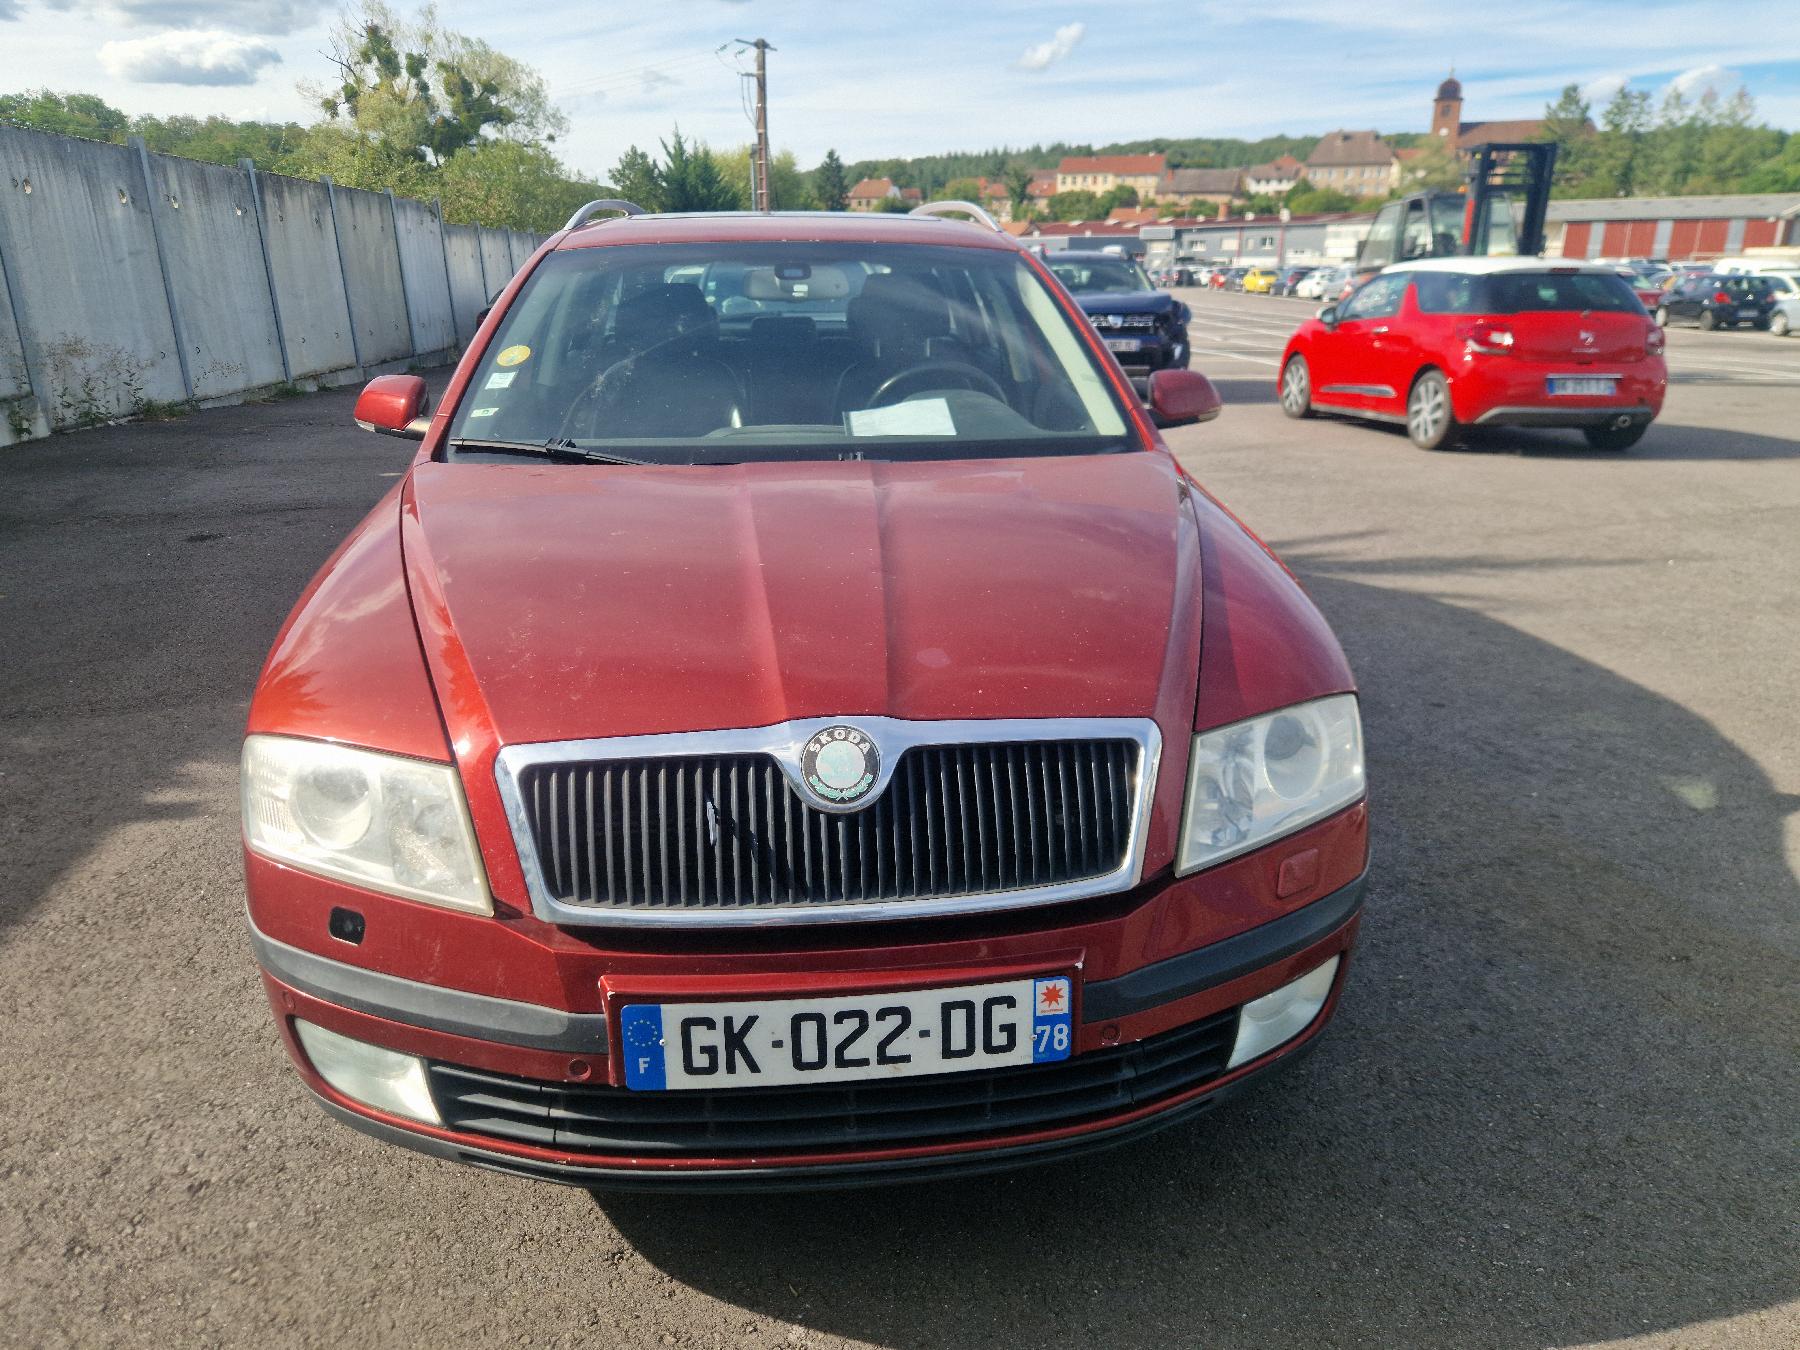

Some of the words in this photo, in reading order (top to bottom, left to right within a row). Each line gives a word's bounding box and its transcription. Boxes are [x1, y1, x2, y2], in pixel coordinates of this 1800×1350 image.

[681, 996, 1016, 1075] GK-022-DG
[1036, 1023, 1068, 1053] 78
[639, 1057, 650, 1074] F
